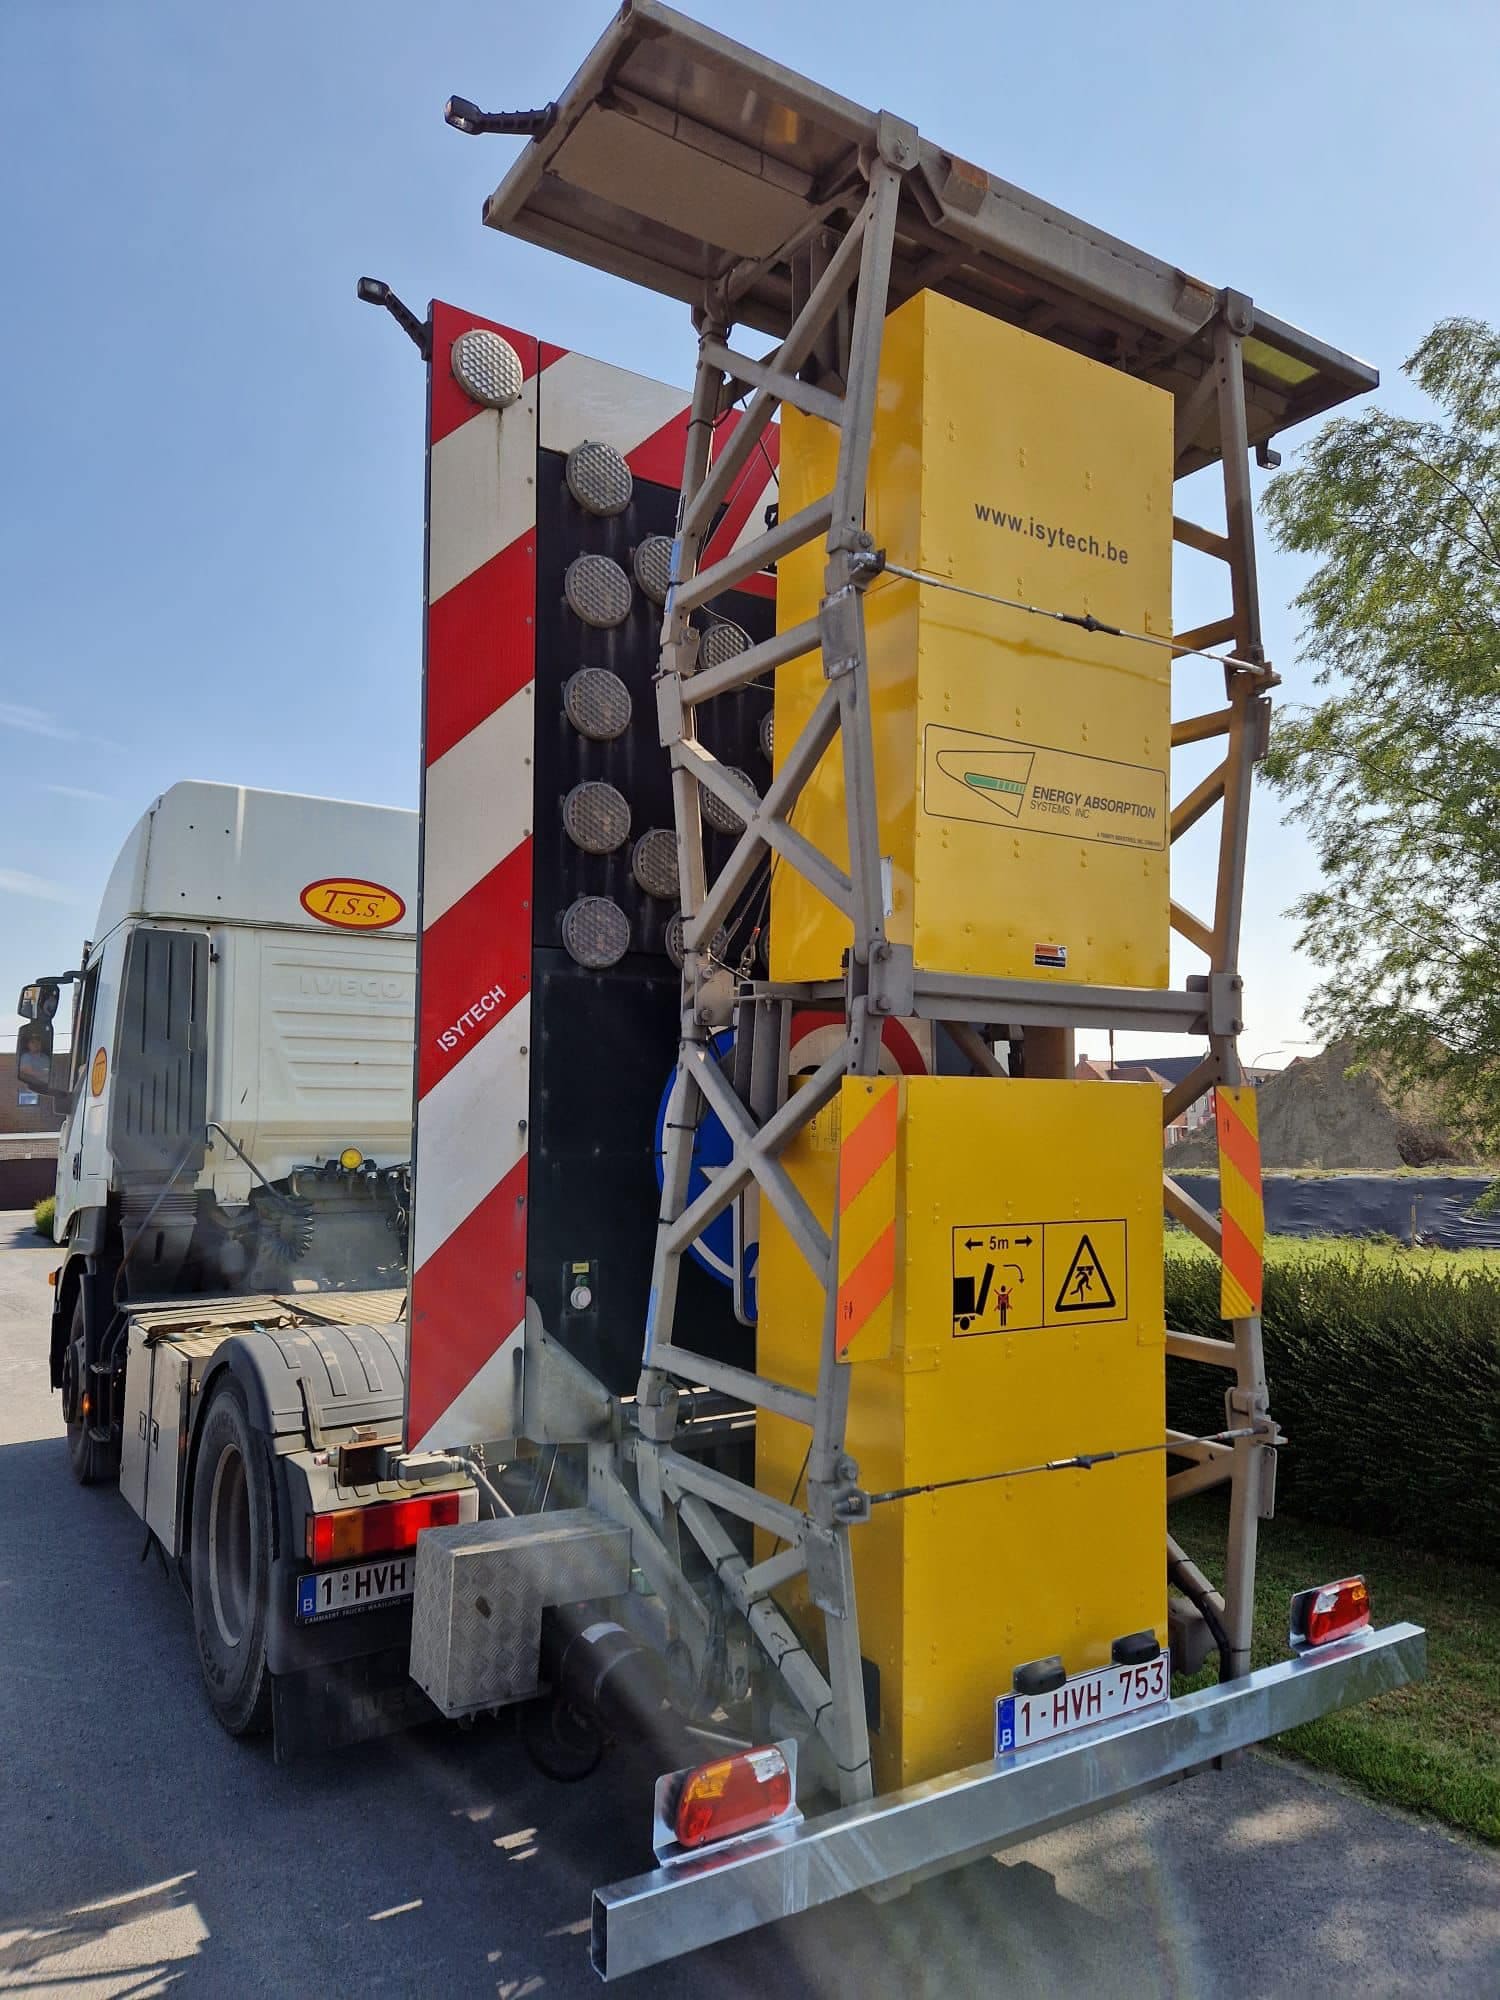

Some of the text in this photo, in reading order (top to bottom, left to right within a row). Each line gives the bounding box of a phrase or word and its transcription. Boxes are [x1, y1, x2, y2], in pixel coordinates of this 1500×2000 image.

[974, 503, 1129, 565] www.isytech.be
[1032, 785, 1157, 819] ENERGY ABSORPTION
[320, 889, 386, 919] T.S.S.
[300, 974, 406, 999] IVECO
[436, 984, 507, 1053] ISYTECH
[989, 1235, 1009, 1250] 5m
[303, 1598, 313, 1612] B
[1002, 1660, 1164, 1747] B 1-HVH-753
